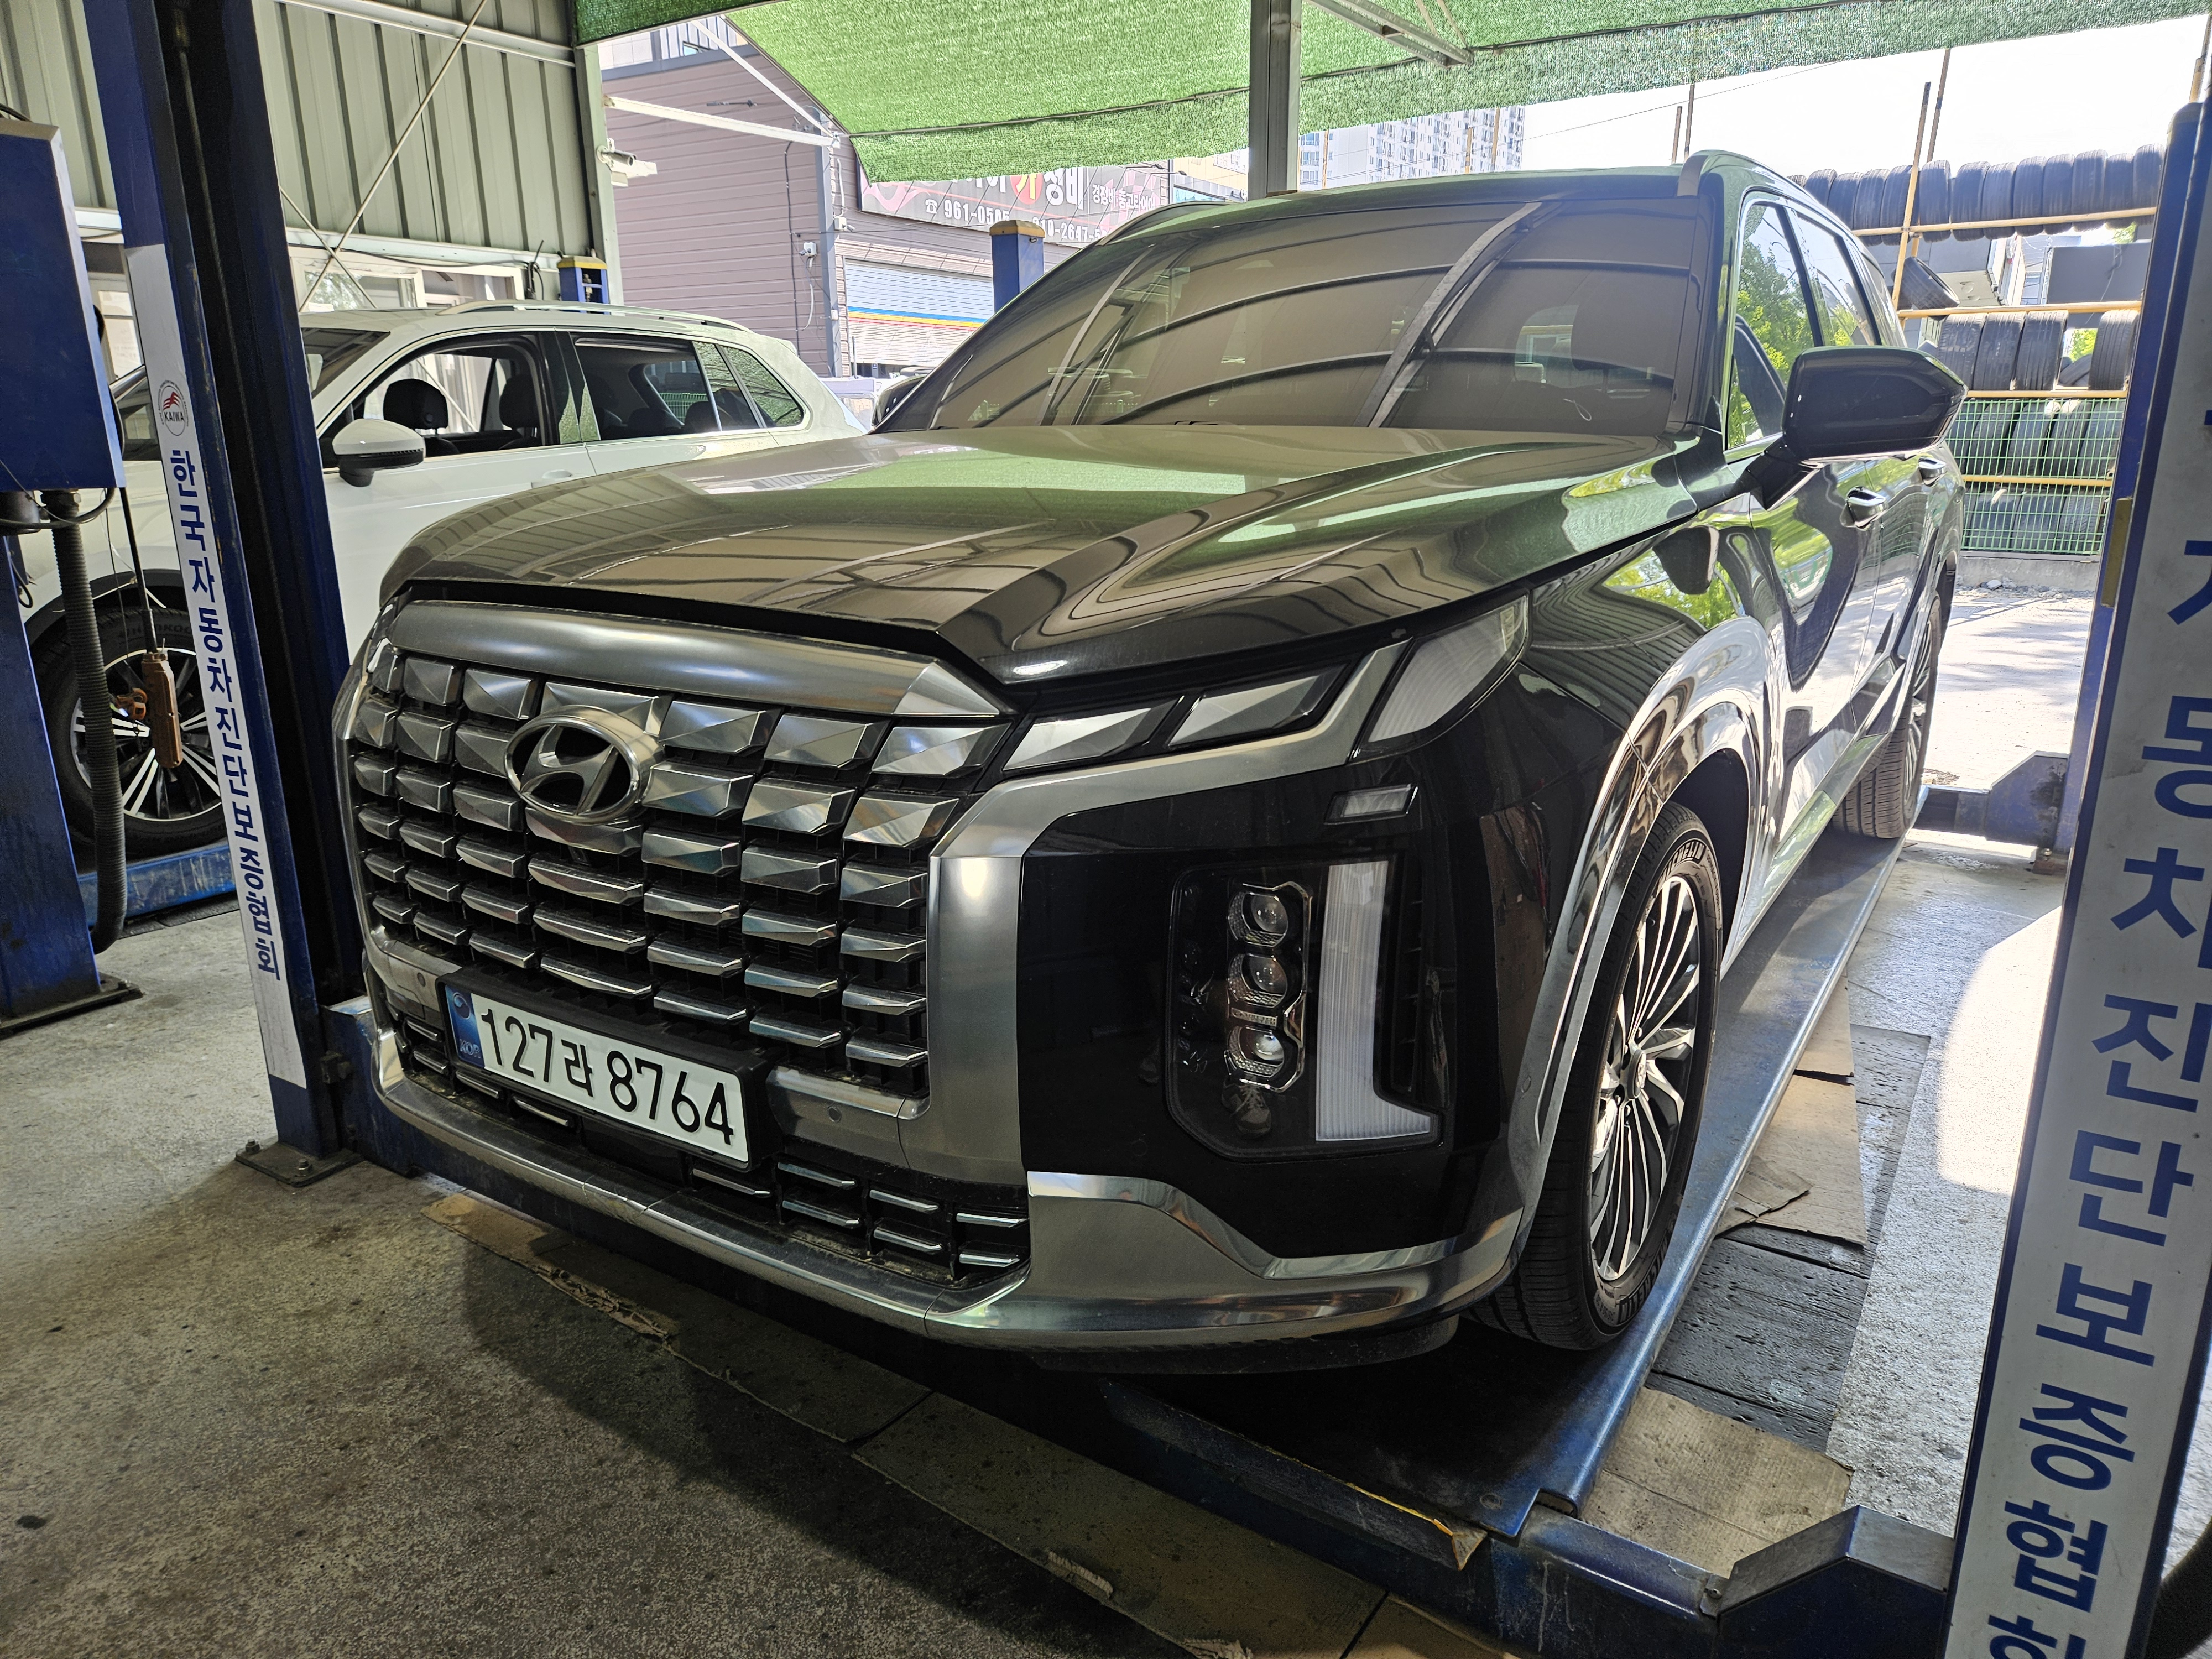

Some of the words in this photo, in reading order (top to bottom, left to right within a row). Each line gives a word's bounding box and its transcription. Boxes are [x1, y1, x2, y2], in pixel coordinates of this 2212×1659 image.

[164, 411, 185, 422] KAIWA
[170, 449, 280, 981] 한국자동차진단보증협회
[481, 1008, 593, 1098] 127라
[607, 1050, 734, 1145] 8764
